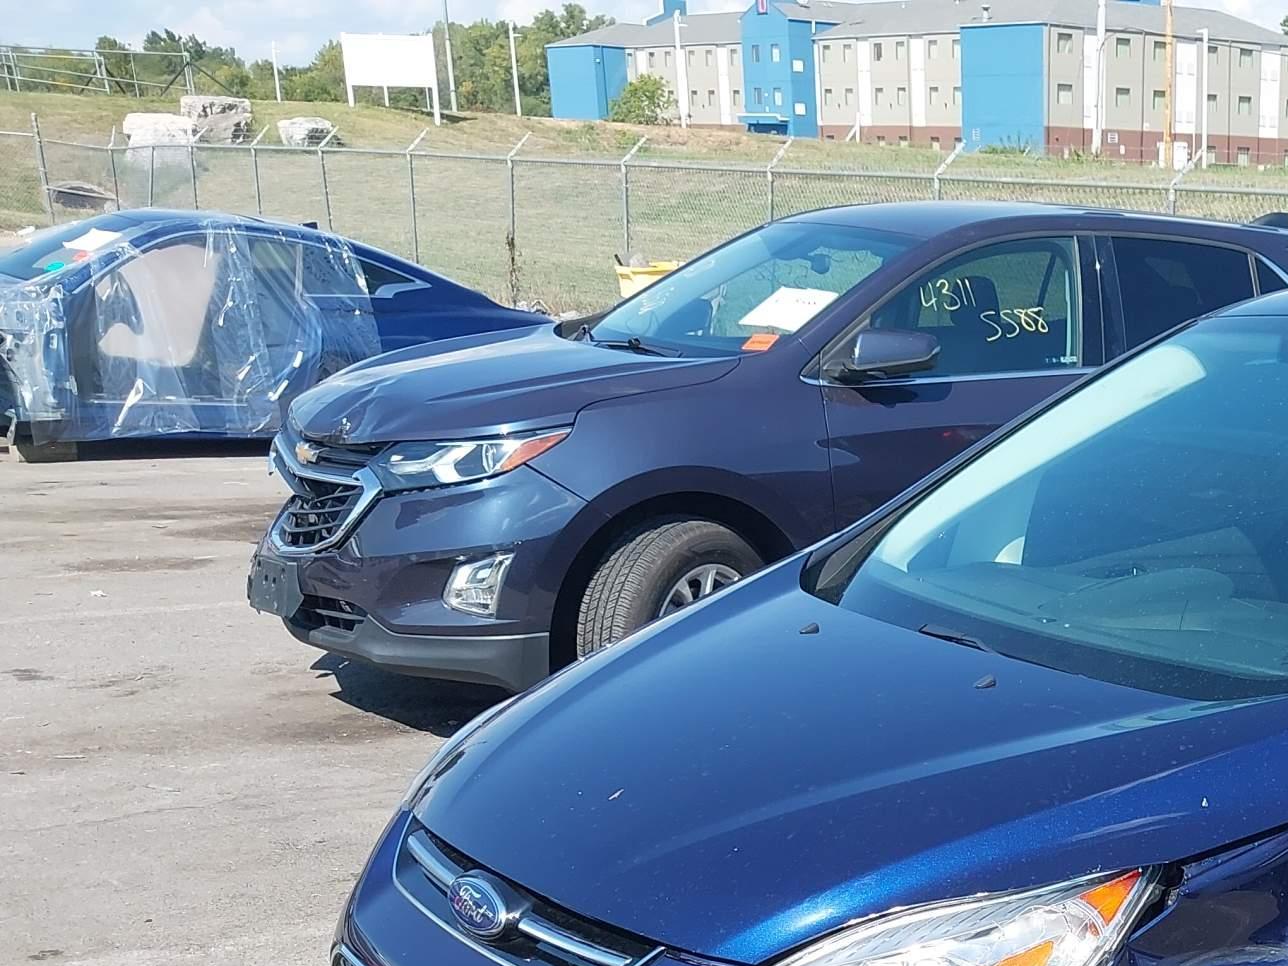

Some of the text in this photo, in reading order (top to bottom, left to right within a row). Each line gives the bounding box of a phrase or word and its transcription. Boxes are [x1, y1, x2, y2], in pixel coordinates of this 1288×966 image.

[919, 278, 977, 312] 4311
[979, 306, 1050, 342] 5588
[453, 885, 495, 923] Ford
